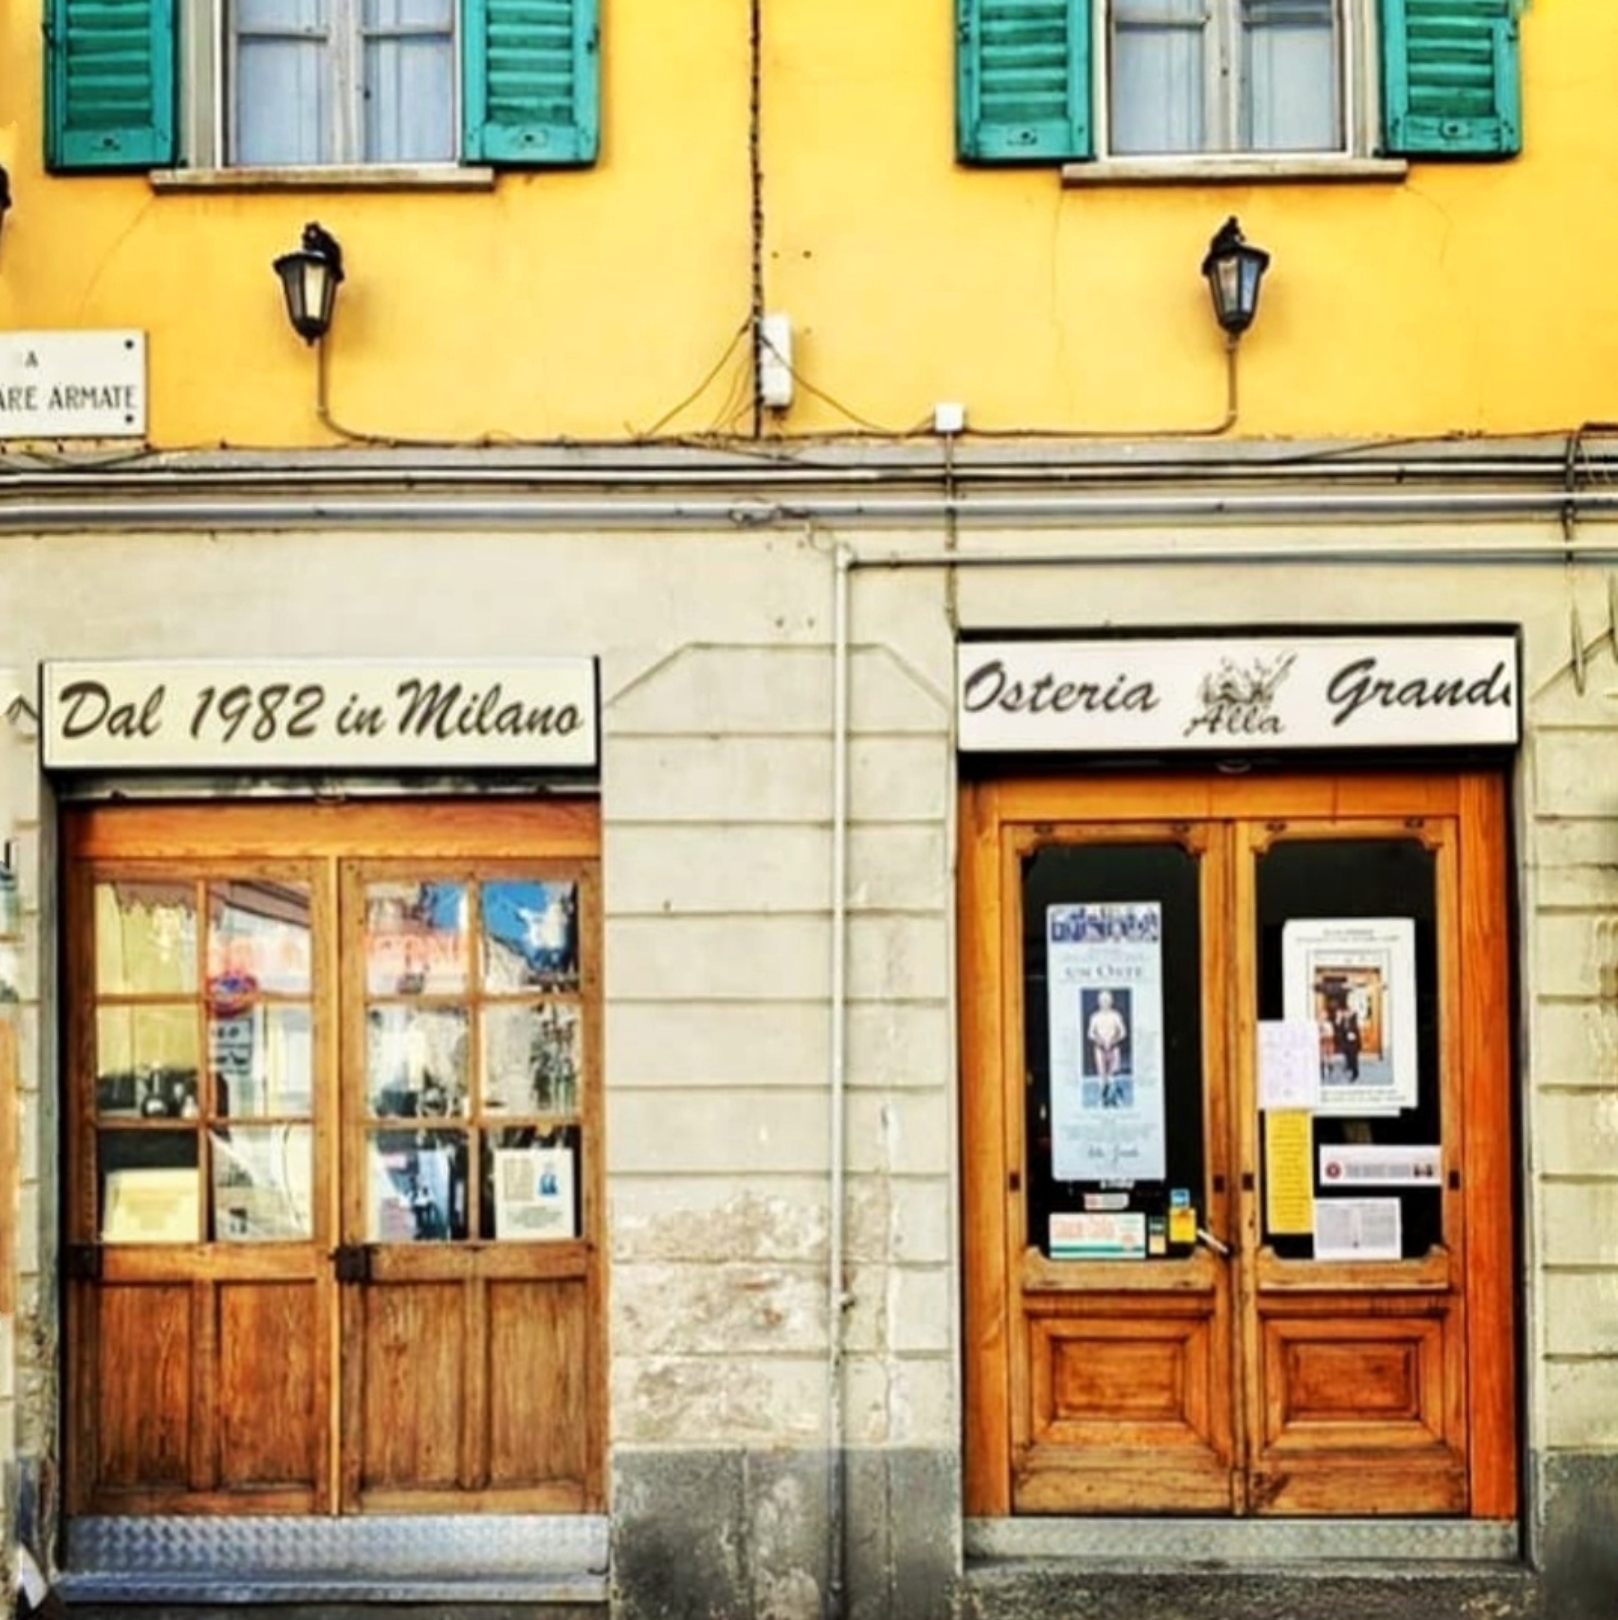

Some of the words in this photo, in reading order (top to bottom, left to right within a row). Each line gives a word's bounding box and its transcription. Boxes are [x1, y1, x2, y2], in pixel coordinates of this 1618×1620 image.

[48, 385, 136, 410] ARMATE
[59, 680, 166, 739] Dal
[190, 684, 325, 743] 1982
[336, 693, 386, 737] in
[397, 679, 584, 740] Milano
[963, 660, 1157, 713] Osteria
[1183, 703, 1284, 737] Alla
